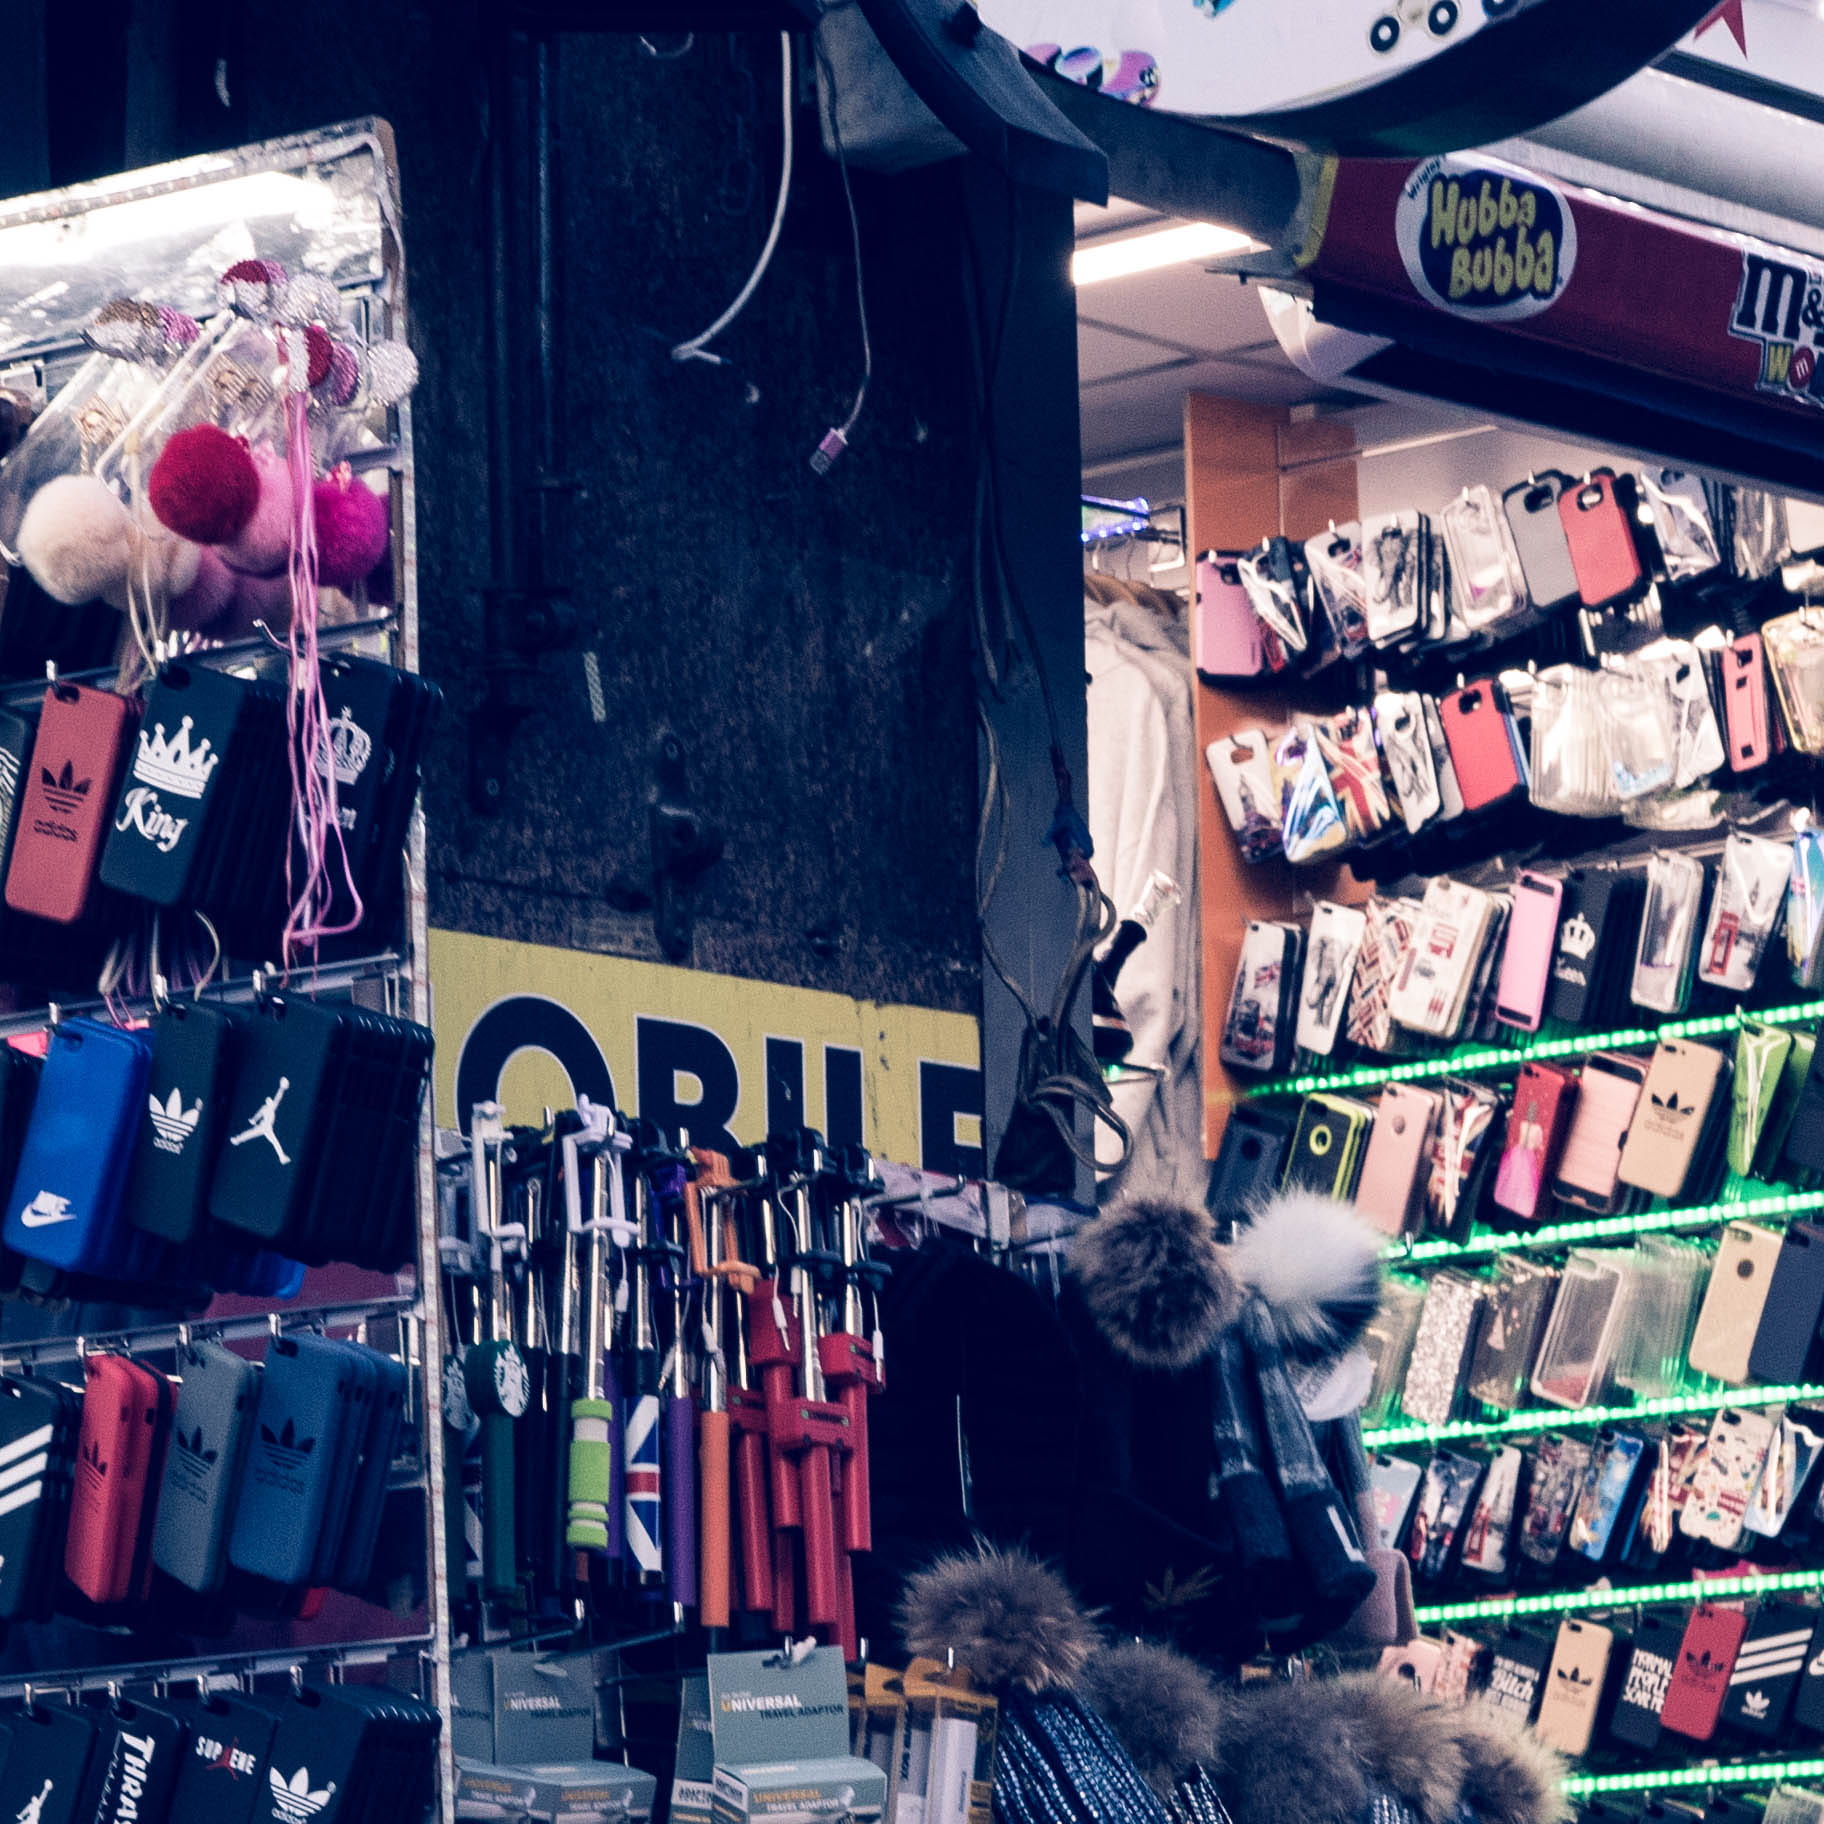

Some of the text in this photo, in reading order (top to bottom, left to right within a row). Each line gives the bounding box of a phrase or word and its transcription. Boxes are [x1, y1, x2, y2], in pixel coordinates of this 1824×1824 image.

[1429, 176, 1538, 249] Hubba
[1448, 227, 1556, 300] Bubba
[115, 784, 189, 853] King
[254, 1465, 306, 1497] adidas
[721, 1694, 802, 1713] UNIVERSAL
